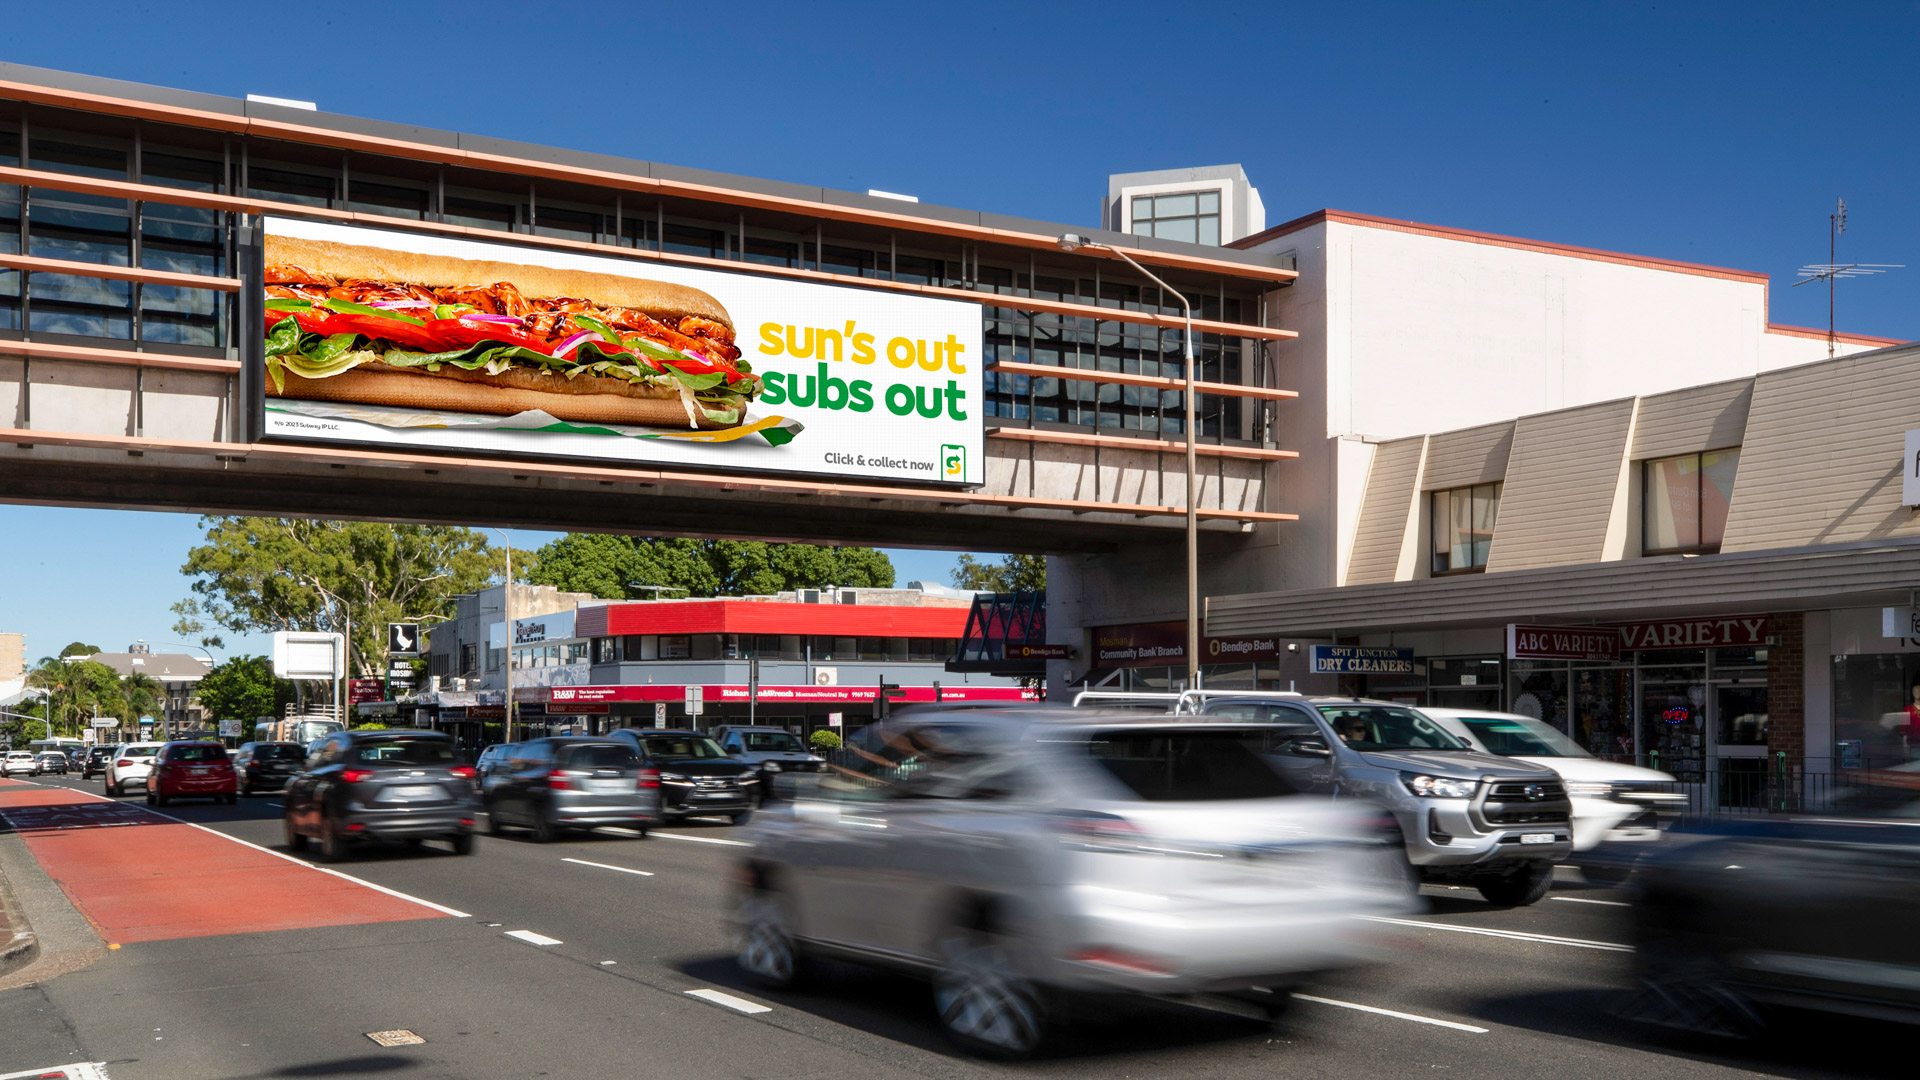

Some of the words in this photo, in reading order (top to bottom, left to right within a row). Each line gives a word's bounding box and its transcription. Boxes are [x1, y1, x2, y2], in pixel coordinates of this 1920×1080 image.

[758, 320, 876, 365] sun's
[886, 334, 967, 374] out
[759, 362, 874, 412] subs
[885, 380, 967, 421] out
[299, 422, 321, 430] Subway
[824, 452, 854, 465] Click
[856, 455, 865, 466] &
[868, 456, 908, 469] collect
[910, 461, 934, 471] now
[1620, 619, 1765, 647] VARIETY
[1100, 637, 1128, 647] Mosman
[1221, 641, 1253, 653] Bendigo
[1254, 640, 1274, 650] Bank
[1518, 633, 1548, 650] ABC
[1553, 634, 1615, 653] VARIETY
[1030, 648, 1051, 656] Bendigo
[1100, 649, 1136, 660] Community
[1158, 645, 1183, 656] Branch
[1331, 648, 1351, 656] SPIT
[1355, 648, 1398, 658] JUNCTION
[394, 661, 412, 669] HOTE
[1318, 658, 1343, 670] DRY
[1347, 659, 1412, 672] CLEANERS
[553, 690, 575, 699] R&W
[1662, 710, 1689, 720] OPEN
[13, 804, 110, 814] BUS
[12, 810, 143, 828] LANE
